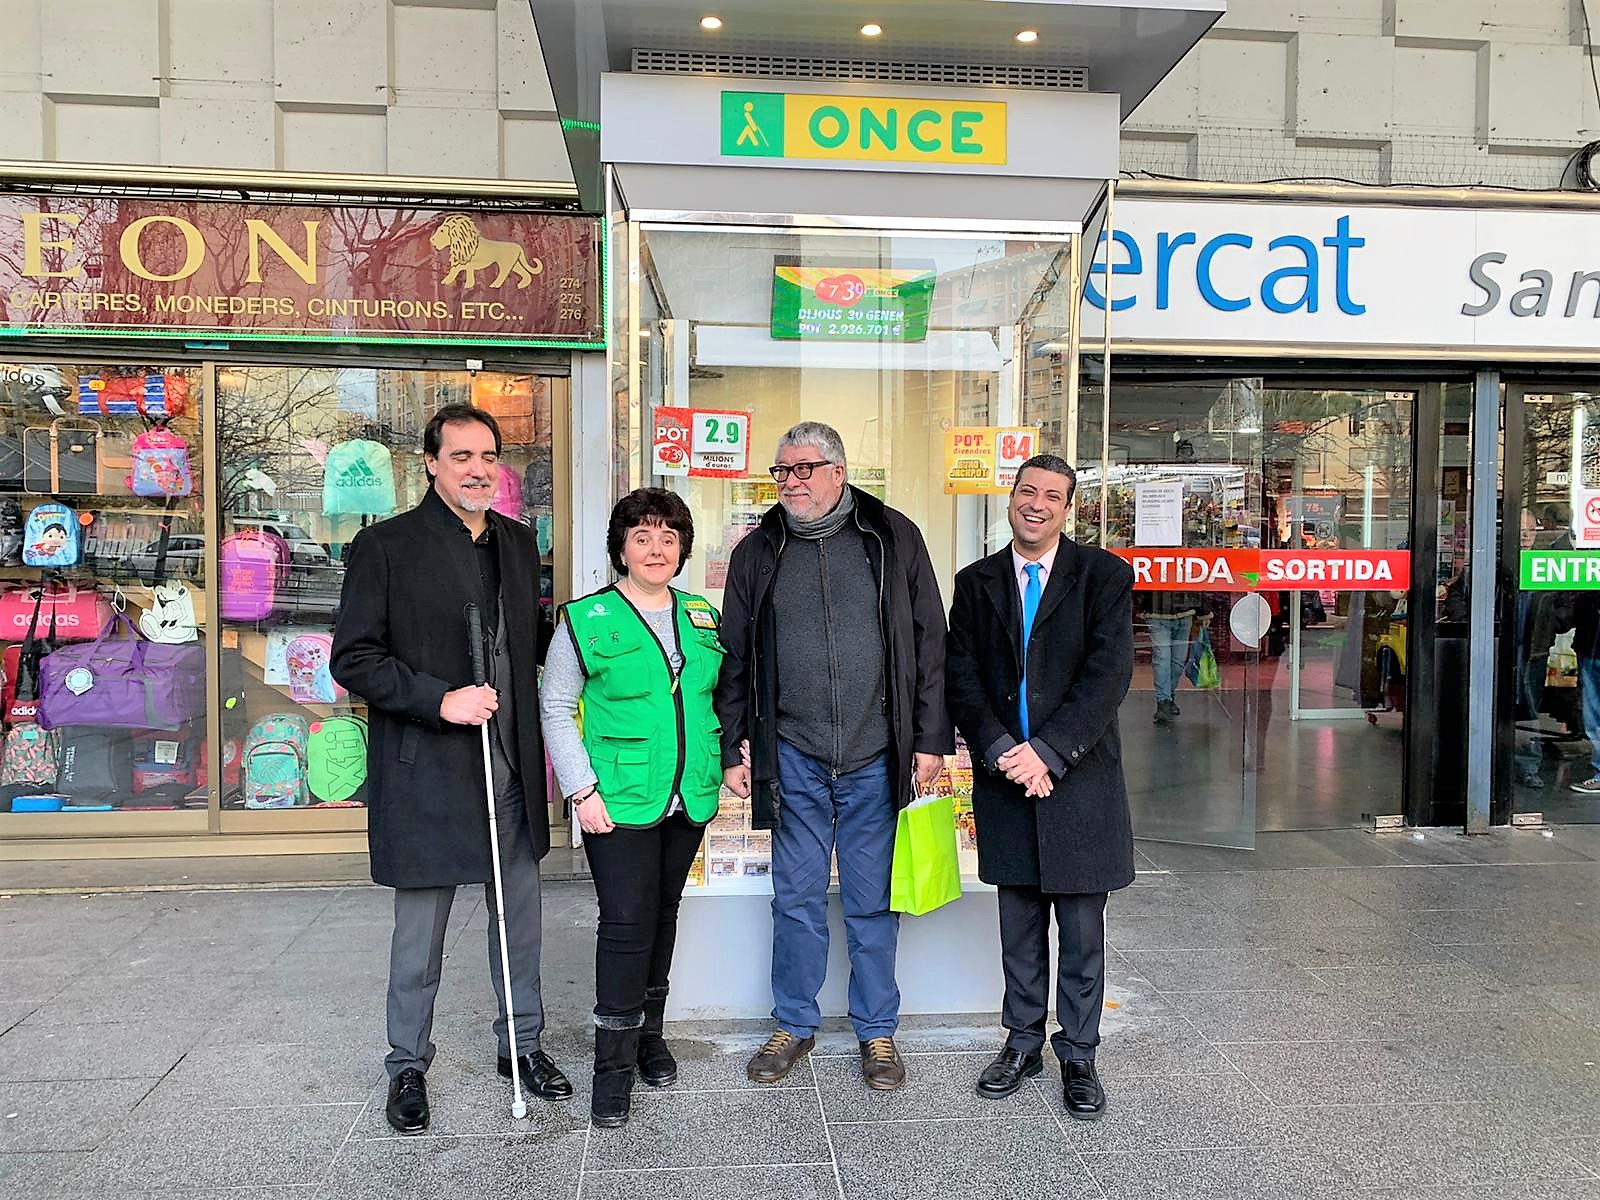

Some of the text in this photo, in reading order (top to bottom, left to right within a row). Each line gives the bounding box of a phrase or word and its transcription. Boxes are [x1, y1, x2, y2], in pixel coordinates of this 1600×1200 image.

[808, 104, 984, 154] ONCE
[20, 212, 321, 285] EON
[1083, 214, 1367, 316] ercat
[559, 277, 581, 289] 274
[11, 292, 524, 321] CARTERES, MONEDERS, CINTURONS. ETC...
[559, 293, 582, 305] 275
[559, 308, 582, 320] 276
[0, 365, 45, 386] idas
[656, 426, 689, 442] POT
[705, 418, 739, 444] 2.9
[953, 434, 984, 447] POT
[953, 447, 992, 455] divendres
[1001, 434, 1031, 461] 84
[702, 455, 735, 463] MILIONS
[335, 475, 382, 488] adidas
[1121, 556, 1235, 584] RTIDA
[1266, 559, 1393, 581] SORTIDA
[1530, 557, 1600, 583] ENTR
[11, 706, 37, 716] adid
